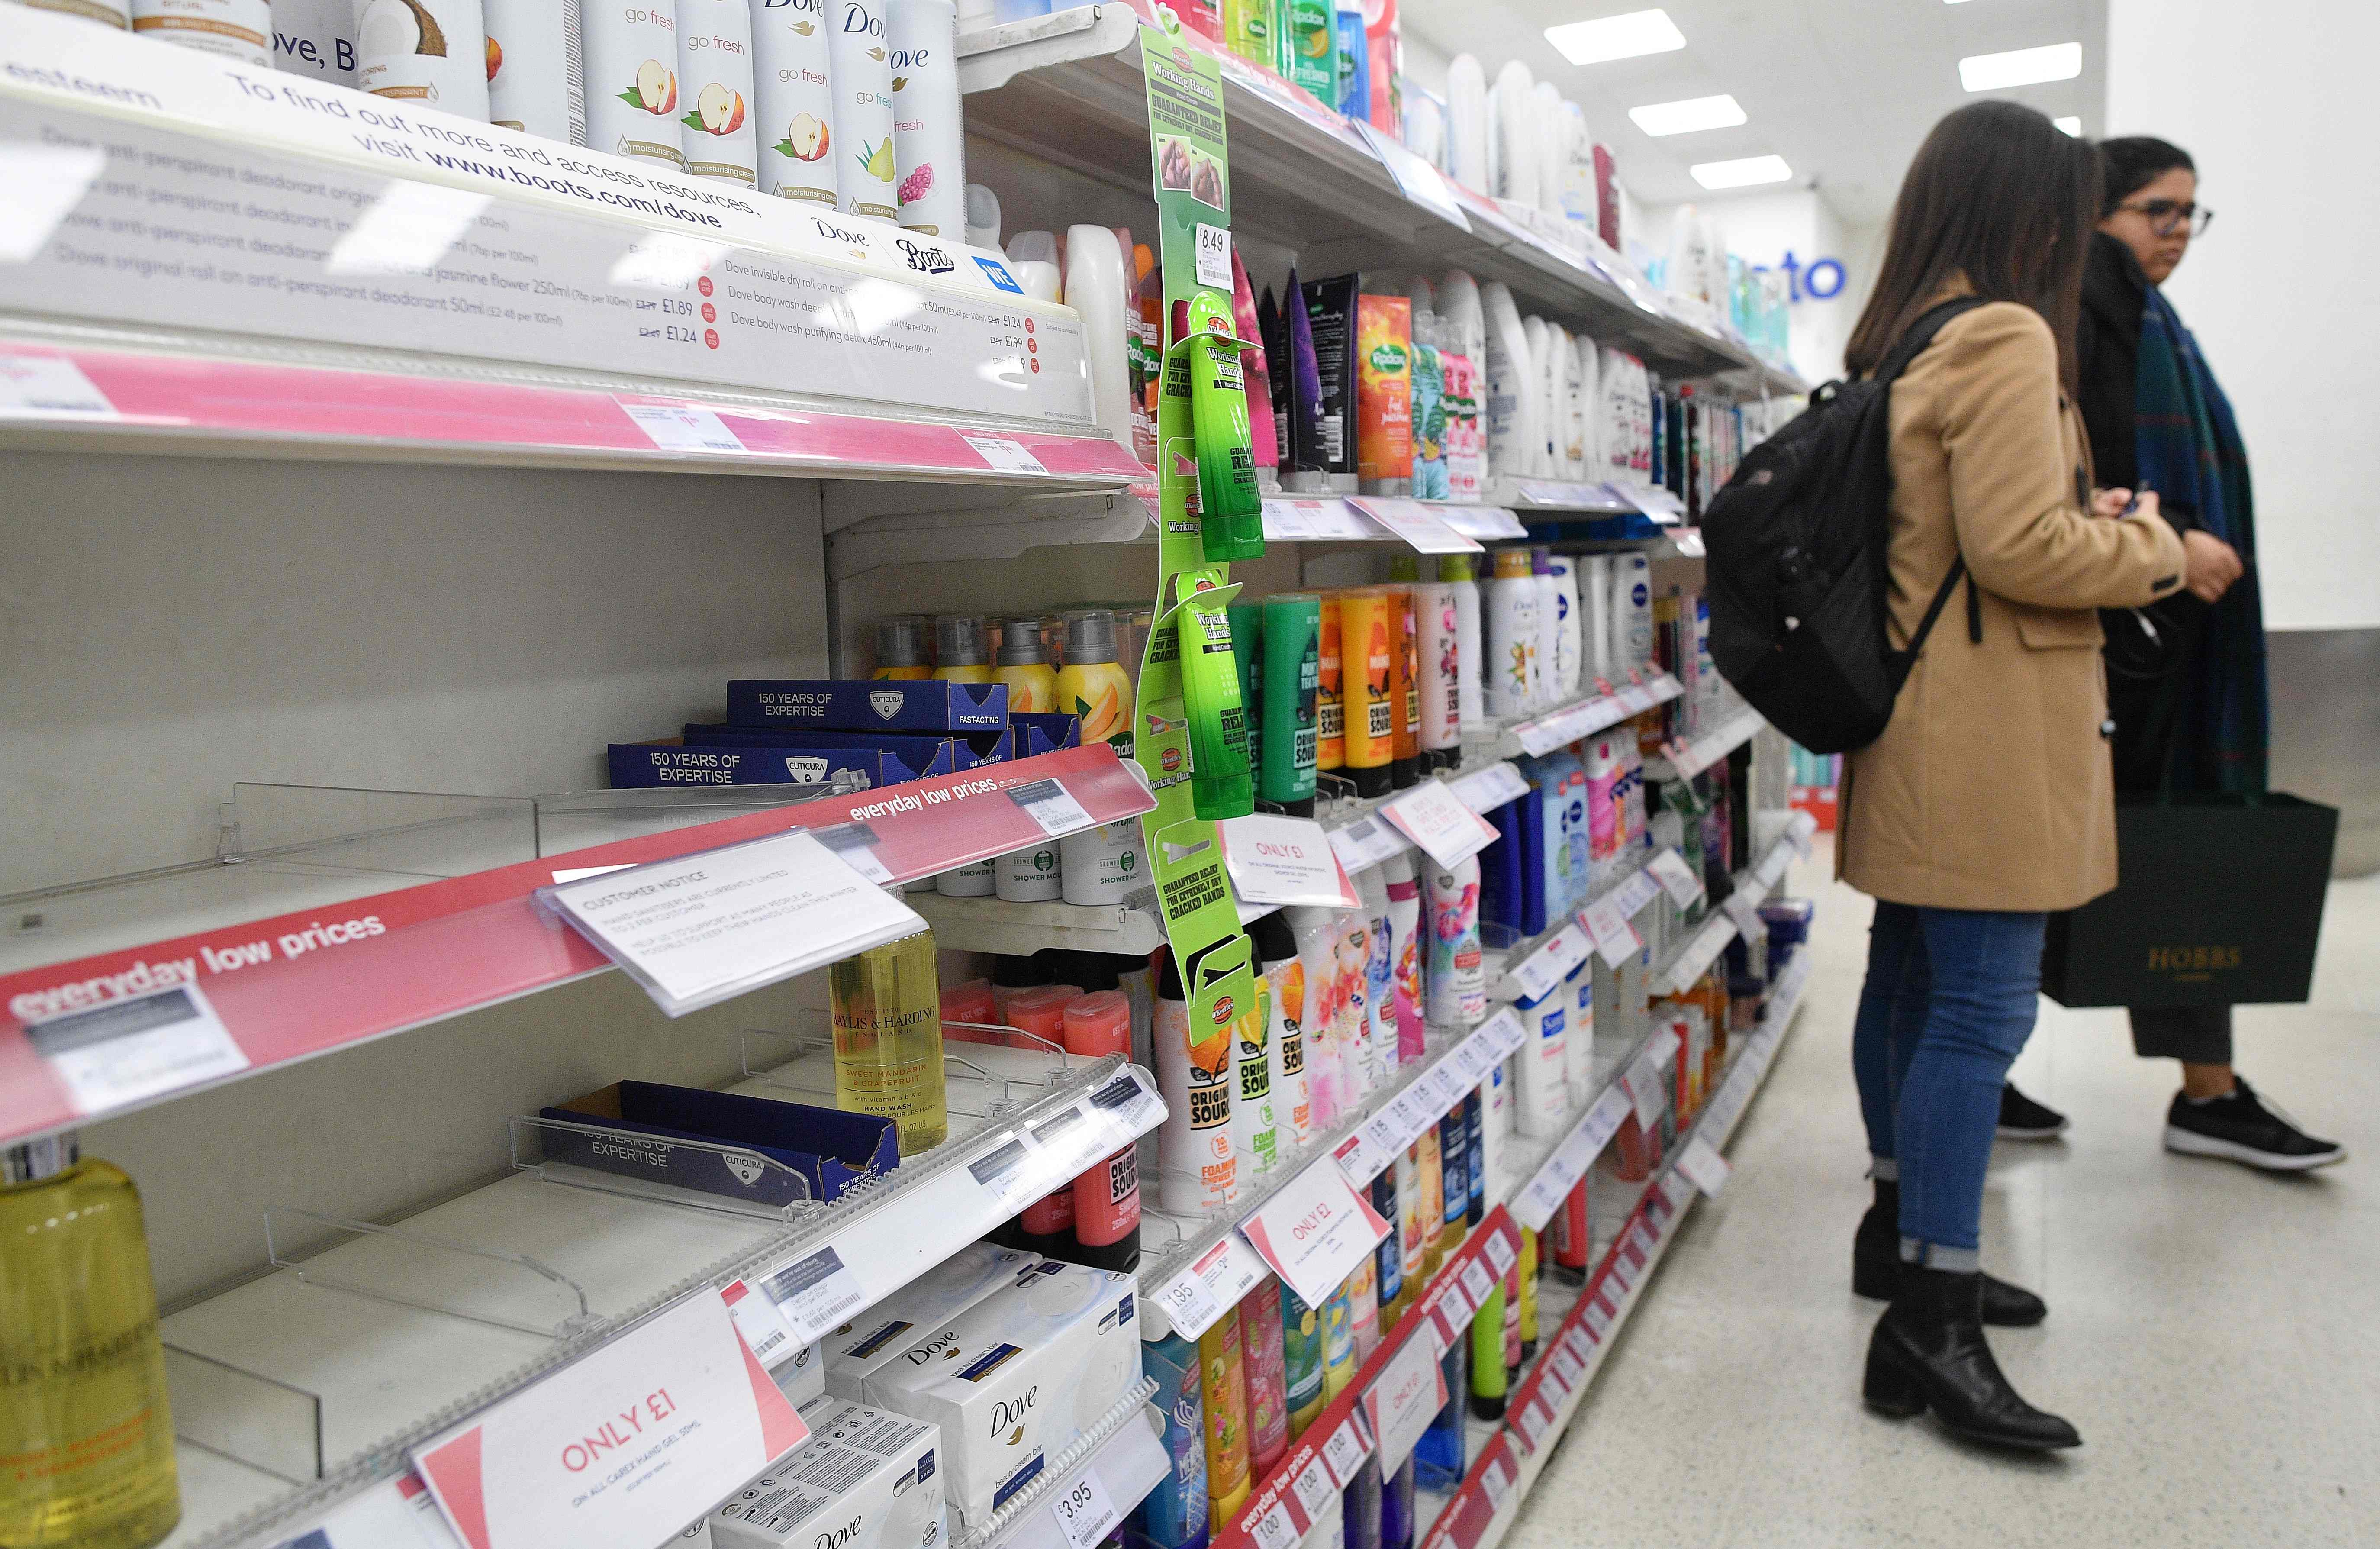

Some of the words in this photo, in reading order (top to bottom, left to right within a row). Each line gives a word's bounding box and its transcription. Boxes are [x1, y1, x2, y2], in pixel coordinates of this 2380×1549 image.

[626, 9, 646, 23] go
[651, 10, 675, 34] fresh
[689, 36, 709, 51] go
[713, 36, 744, 55] fresh
[779, 69, 798, 83] go
[802, 68, 827, 87] fresh
[1152, 60, 1190, 92] Working
[1190, 78, 1215, 100] Hands
[857, 92, 873, 104] go
[894, 119, 924, 132] fresh
[225, 72, 274, 100] To
[283, 87, 350, 118] find
[359, 109, 412, 133] out
[417, 122, 493, 152] more
[500, 142, 551, 166] and
[557, 157, 644, 187] access
[647, 178, 761, 218] resources,
[633, 144, 674, 161] moisturising
[354, 132, 422, 163] visit
[426, 150, 722, 228] www.boots.com/dove
[694, 165, 738, 177] moisturising
[739, 170, 754, 180] cream
[786, 189, 826, 200] moisturising
[862, 206, 894, 217] moisturising
[810, 216, 870, 246] Dove
[896, 239, 954, 274] Boots
[725, 260, 749, 275] Dove
[751, 265, 785, 284] invisible
[787, 274, 800, 289] dry
[802, 278, 815, 290] roll
[817, 282, 828, 290] on
[982, 263, 1015, 287] WE
[436, 269, 489, 286] jasmine
[491, 271, 530, 291] flower
[532, 279, 570, 299] 250ml
[663, 298, 693, 316] £1.89
[728, 286, 752, 301] Dove
[754, 290, 776, 309] body
[778, 297, 800, 310] wash
[450, 297, 485, 316] 50ml
[667, 326, 697, 343] £1.24
[929, 301, 947, 315] 50ml
[1003, 315, 1021, 329] £1.24
[731, 311, 755, 327] Dove
[757, 316, 779, 333] body
[781, 323, 803, 336] wash
[805, 327, 843, 343] purifying
[844, 333, 866, 344] detox
[868, 336, 891, 348] 450ml
[892, 341, 905, 352] (44p
[906, 345, 915, 353] per
[915, 345, 932, 355] 100ml)
[899, 320, 912, 330] (44p
[913, 323, 921, 332] per
[921, 324, 938, 336] 100ml)
[1005, 336, 1022, 349] £1.99
[1206, 347, 1240, 365] Working
[1167, 371, 1179, 382] FOR
[1218, 362, 1242, 379] Hands
[1168, 520, 1199, 534] Working
[1205, 627, 1231, 640] Hands
[759, 693, 775, 704] 150
[777, 693, 815, 704] YEARS
[817, 693, 833, 704] OF
[872, 696, 902, 704] CUTICURA
[765, 705, 825, 717] EXPERTISE
[959, 715, 999, 725] FAST-ACTING
[650, 752, 670, 765] 150
[673, 752, 718, 768] YEARS
[721, 755, 741, 768] OF
[789, 762, 825, 771] CUTICURA
[979, 757, 995, 766] YEARS
[659, 768, 733, 784] EXPERTISE
[850, 794, 923, 821] everyday
[920, 788, 952, 806] low
[952, 778, 998, 800] prices
[1256, 842, 1288, 858] ONLY
[960, 869, 989, 877] SHOWER
[1100, 876, 1130, 884] SHOWER
[1163, 871, 1199, 896] GUARANTEED
[1200, 864, 1218, 880] RELIEF
[582, 884, 656, 911] CUSTOMER
[659, 870, 709, 890] NOTICE
[1167, 894, 1178, 908] FOR
[1179, 881, 1211, 904] EXTREMELY
[1212, 875, 1222, 891] DRY
[1169, 897, 1202, 921] CRACKED
[1203, 886, 1225, 905] HANDS
[10, 958, 196, 1021] everyday
[202, 939, 272, 974] low
[278, 914, 386, 958] prices
[833, 1013, 867, 1029] BAYLIS
[871, 1017, 882, 1029] &
[884, 1006, 935, 1029] HARDING
[1212, 1001, 1234, 1020] O'Keeffe's
[846, 1069, 873, 1078] SWEET
[877, 1064, 927, 1078] MANDARIN
[861, 1075, 920, 1087] GRAPEFRUIT
[889, 1103, 912, 1112] WASH
[920, 1103, 935, 1113] MAINS
[900, 1124, 908, 1133] FL
[592, 1141, 668, 1168] EXPERTISE
[726, 1155, 761, 1170] CUTICURA
[838, 1179, 850, 1192] 150
[850, 1171, 871, 1186] YEARS
[871, 1163, 881, 1173] OF
[1293, 1211, 1320, 1240] ONLY
[1316, 1202, 1332, 1219] £2
[839, 1338, 863, 1355] beauty
[861, 1327, 881, 1341] cream
[879, 1320, 890, 1330] bar
[901, 1330, 960, 1366] Dove
[949, 1360, 973, 1378] beauty
[970, 1349, 991, 1363] cream
[987, 1342, 999, 1351] bar
[990, 1385, 1037, 1439] Dove
[562, 1405, 643, 1472] ONLY
[646, 1387, 677, 1423] £1
[573, 1493, 589, 1508] ON
[590, 1482, 606, 1497] ALL
[606, 1460, 637, 1485] CAREX
[637, 1444, 663, 1465] HAND
[662, 1434, 680, 1449] GEL
[678, 1419, 702, 1438] 50ML
[920, 1467, 934, 1481] BARS
[995, 1469, 1014, 1489] beauty
[1014, 1453, 1032, 1472] cream
[1032, 1444, 1043, 1456] bar
[1059, 1481, 1092, 1519] £3.95
[1240, 1487, 1279, 1533] everyday
[1272, 1470, 1291, 1493] low
[1288, 1444, 1314, 1478] prices
[814, 1515, 862, 1549] Dove
